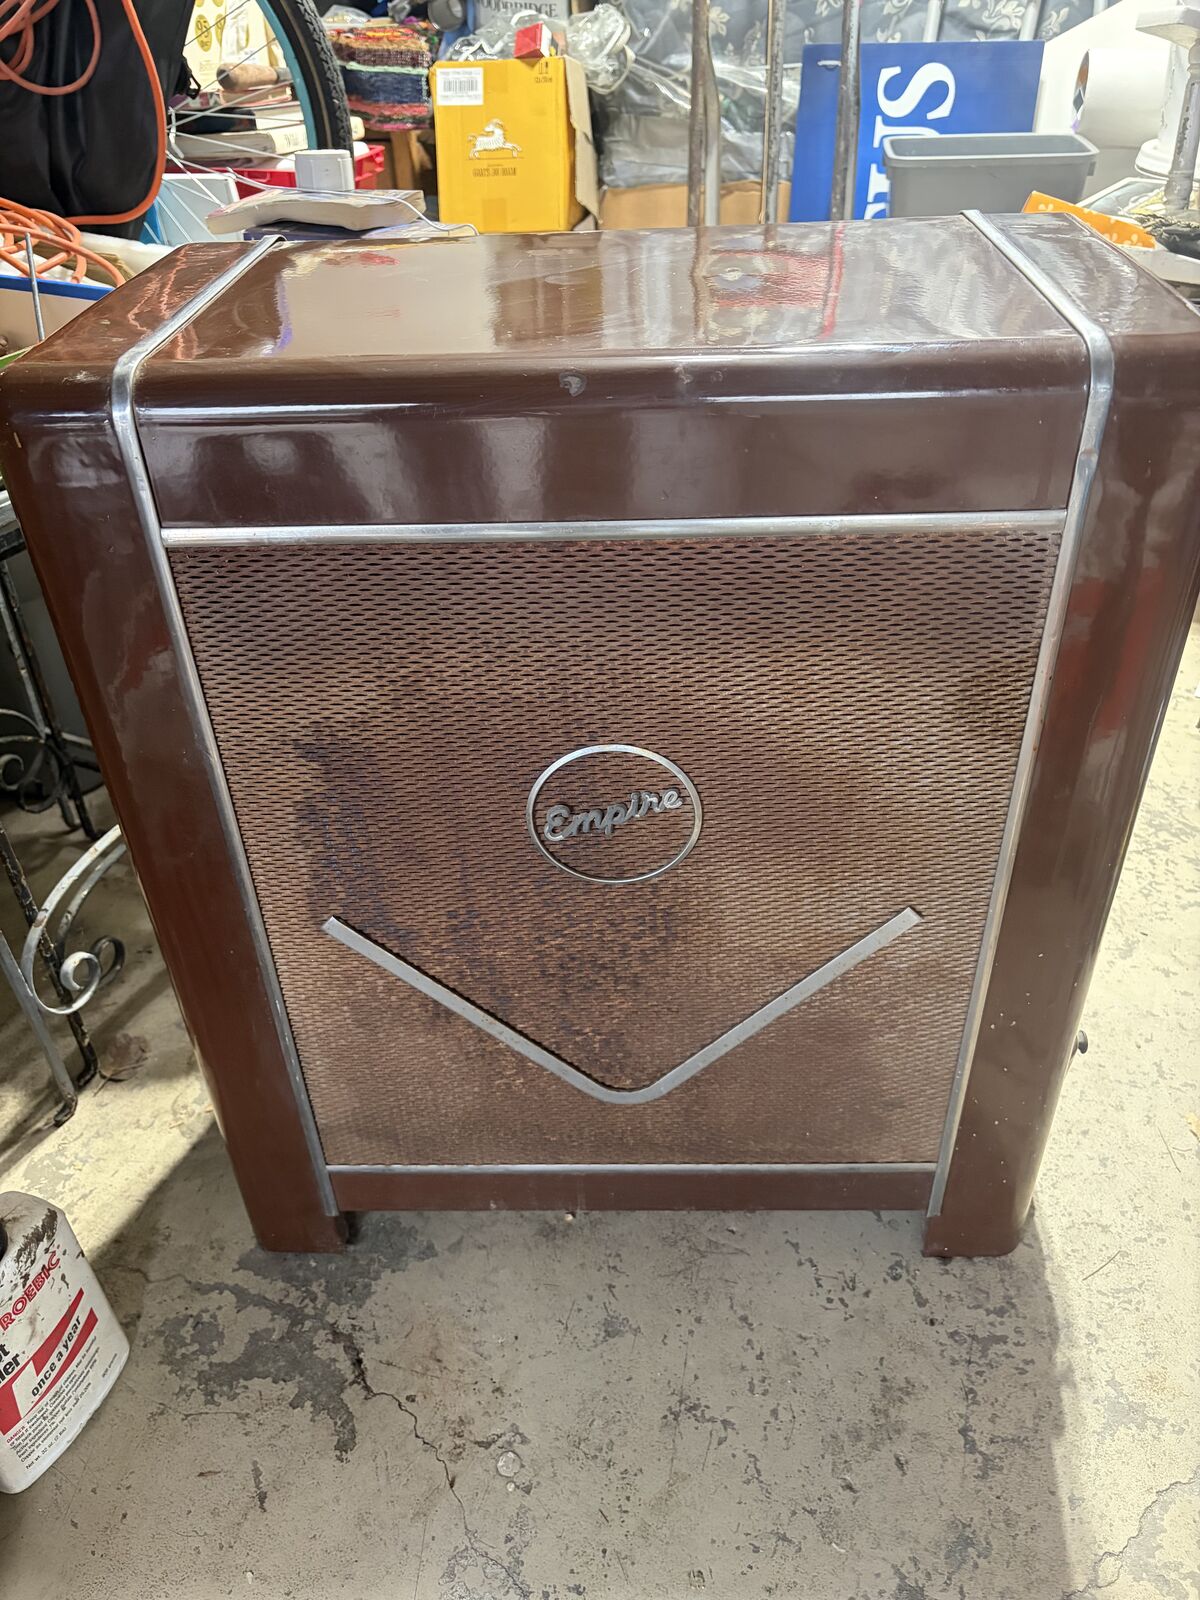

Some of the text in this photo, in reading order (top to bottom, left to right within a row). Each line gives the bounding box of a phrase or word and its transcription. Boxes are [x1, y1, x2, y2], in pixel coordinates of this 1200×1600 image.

[544, 786, 684, 842] Empire
[0, 1251, 61, 1331] ROEBIC
[31, 1364, 56, 1398] once
[56, 1350, 64, 1363] a
[62, 1315, 82, 1353] year
